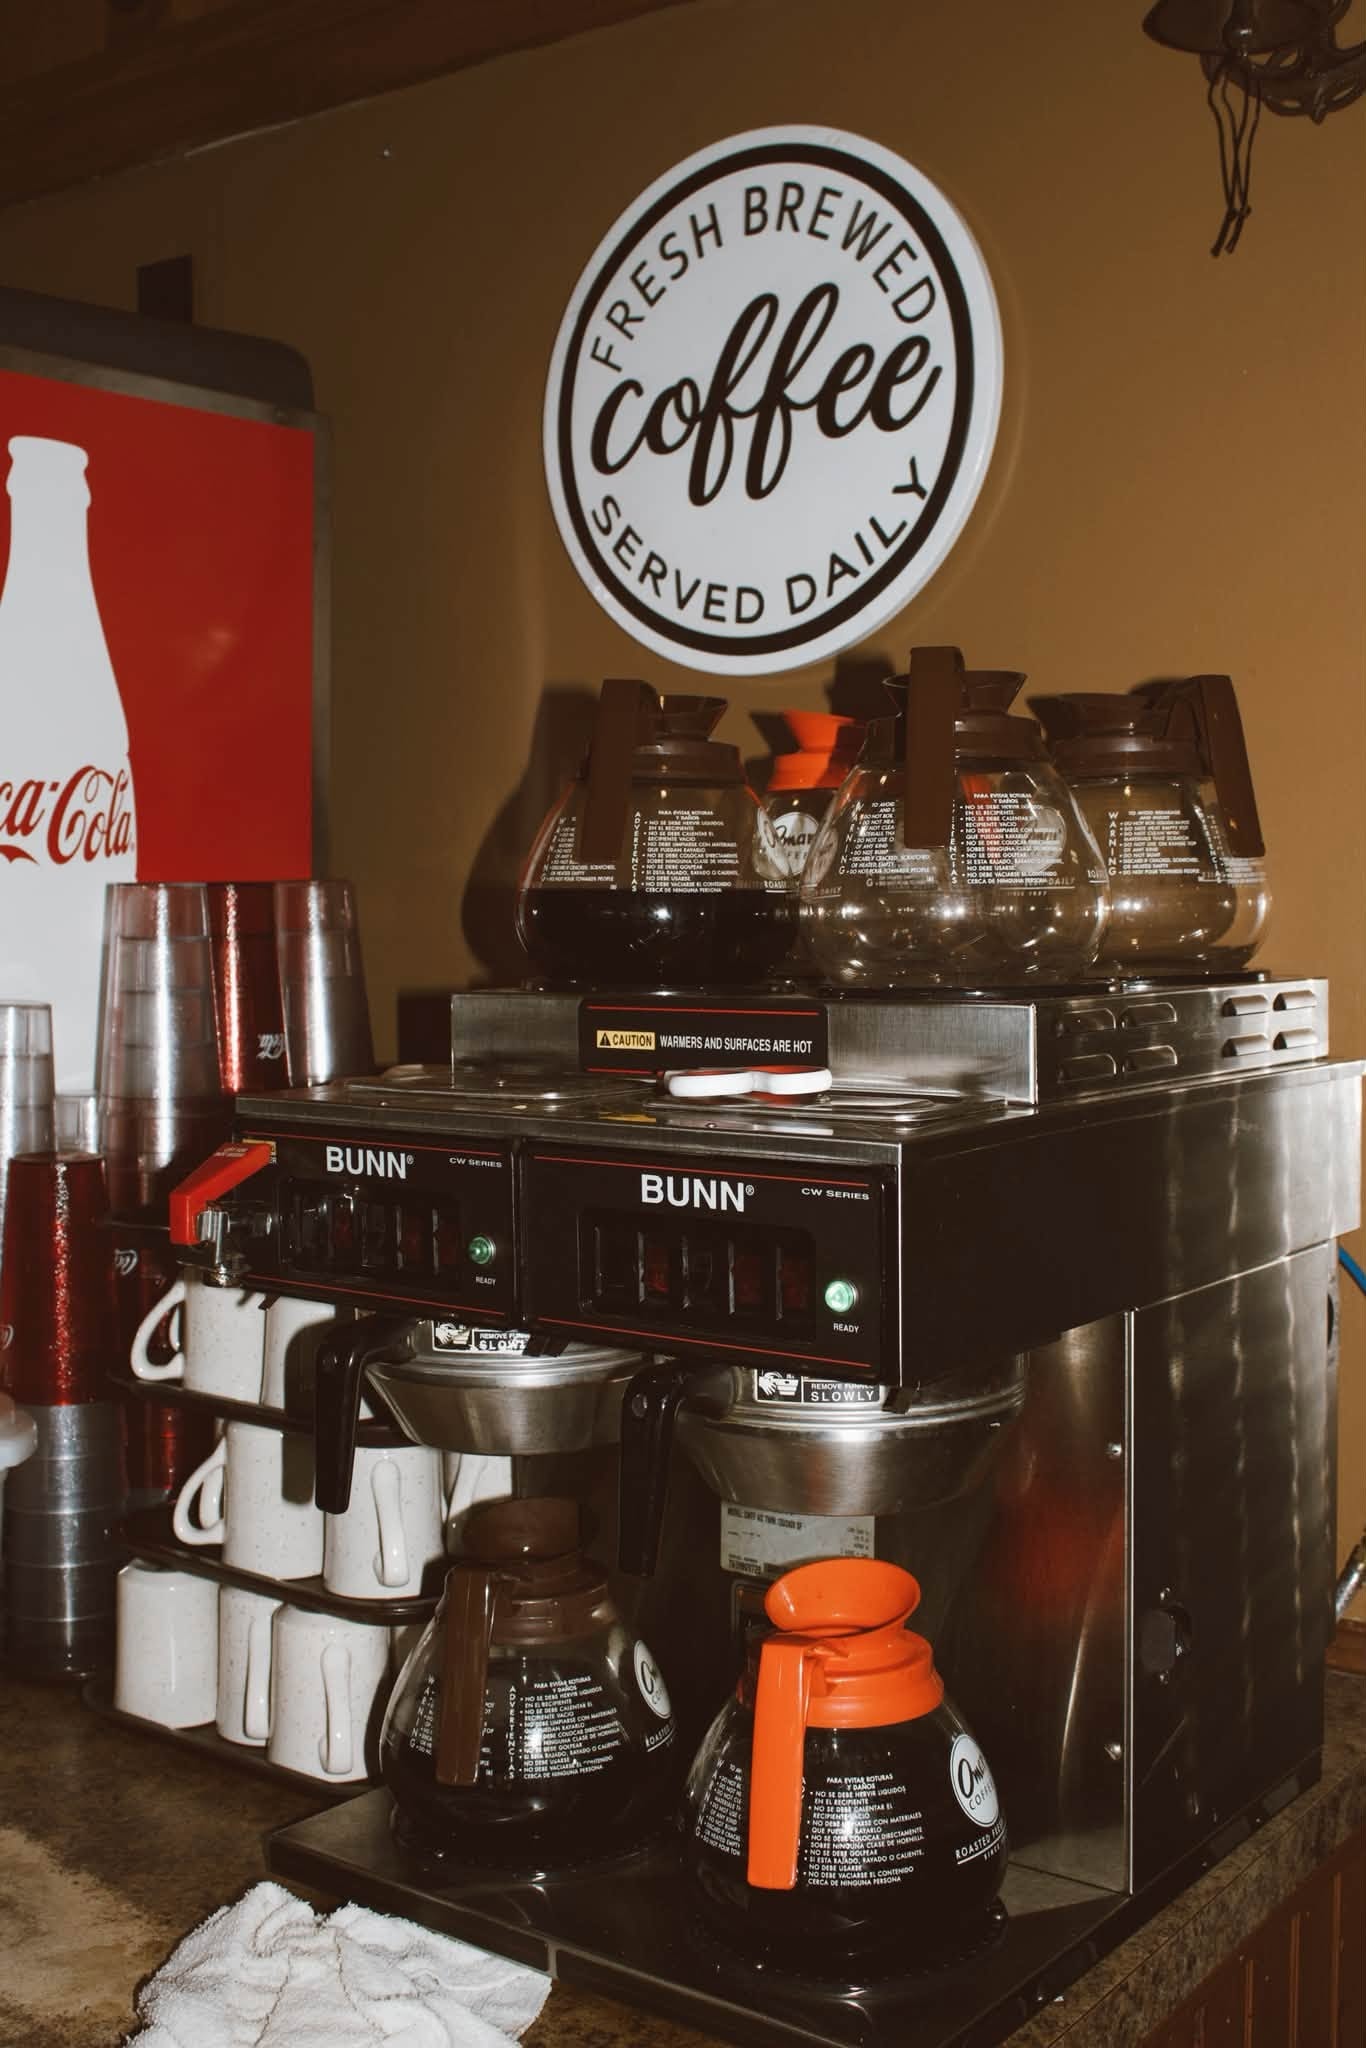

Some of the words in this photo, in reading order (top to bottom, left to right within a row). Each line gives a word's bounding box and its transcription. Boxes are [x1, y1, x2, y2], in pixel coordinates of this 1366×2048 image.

[591, 204, 723, 372] FRESH
[744, 181, 937, 325] BREWED
[590, 283, 943, 506] coffee
[593, 495, 765, 624] SERVED
[786, 457, 928, 614] DAILY
[1108, 812, 1118, 876] WARNING
[612, 1034, 652, 1047] CAUTION
[659, 1035, 703, 1049] WARMERS
[704, 1038, 723, 1049] AND
[724, 1038, 771, 1052] SURFACES
[772, 1040, 791, 1052] ARE
[793, 1041, 813, 1053] HOT
[449, 1157, 465, 1165] CW
[468, 1158, 502, 1168] SERIES
[801, 1187, 823, 1196] CW
[826, 1190, 870, 1200] SERIES
[476, 1277, 496, 1285] READY
[833, 1322, 859, 1333] READY
[811, 1391, 875, 1401] SLOWLY
[508, 1686, 516, 1779] ADVERTENCIAS
[844, 1776, 865, 1784] EVITAR
[866, 1773, 893, 1782] ROTURAS
[855, 1790, 876, 1798] HERVIR
[854, 1804, 885, 1813] CALENTAR
[873, 1818, 888, 1826] CON
[890, 1812, 921, 1824] MATERIALES
[850, 1834, 879, 1842] COLOCAR
[881, 1827, 922, 1839] DIRECTAMENTE
[956, 1834, 990, 1860] ROASTED
[878, 1866, 914, 1877] CONTENIDO
[873, 1876, 901, 1885] PERSONA
